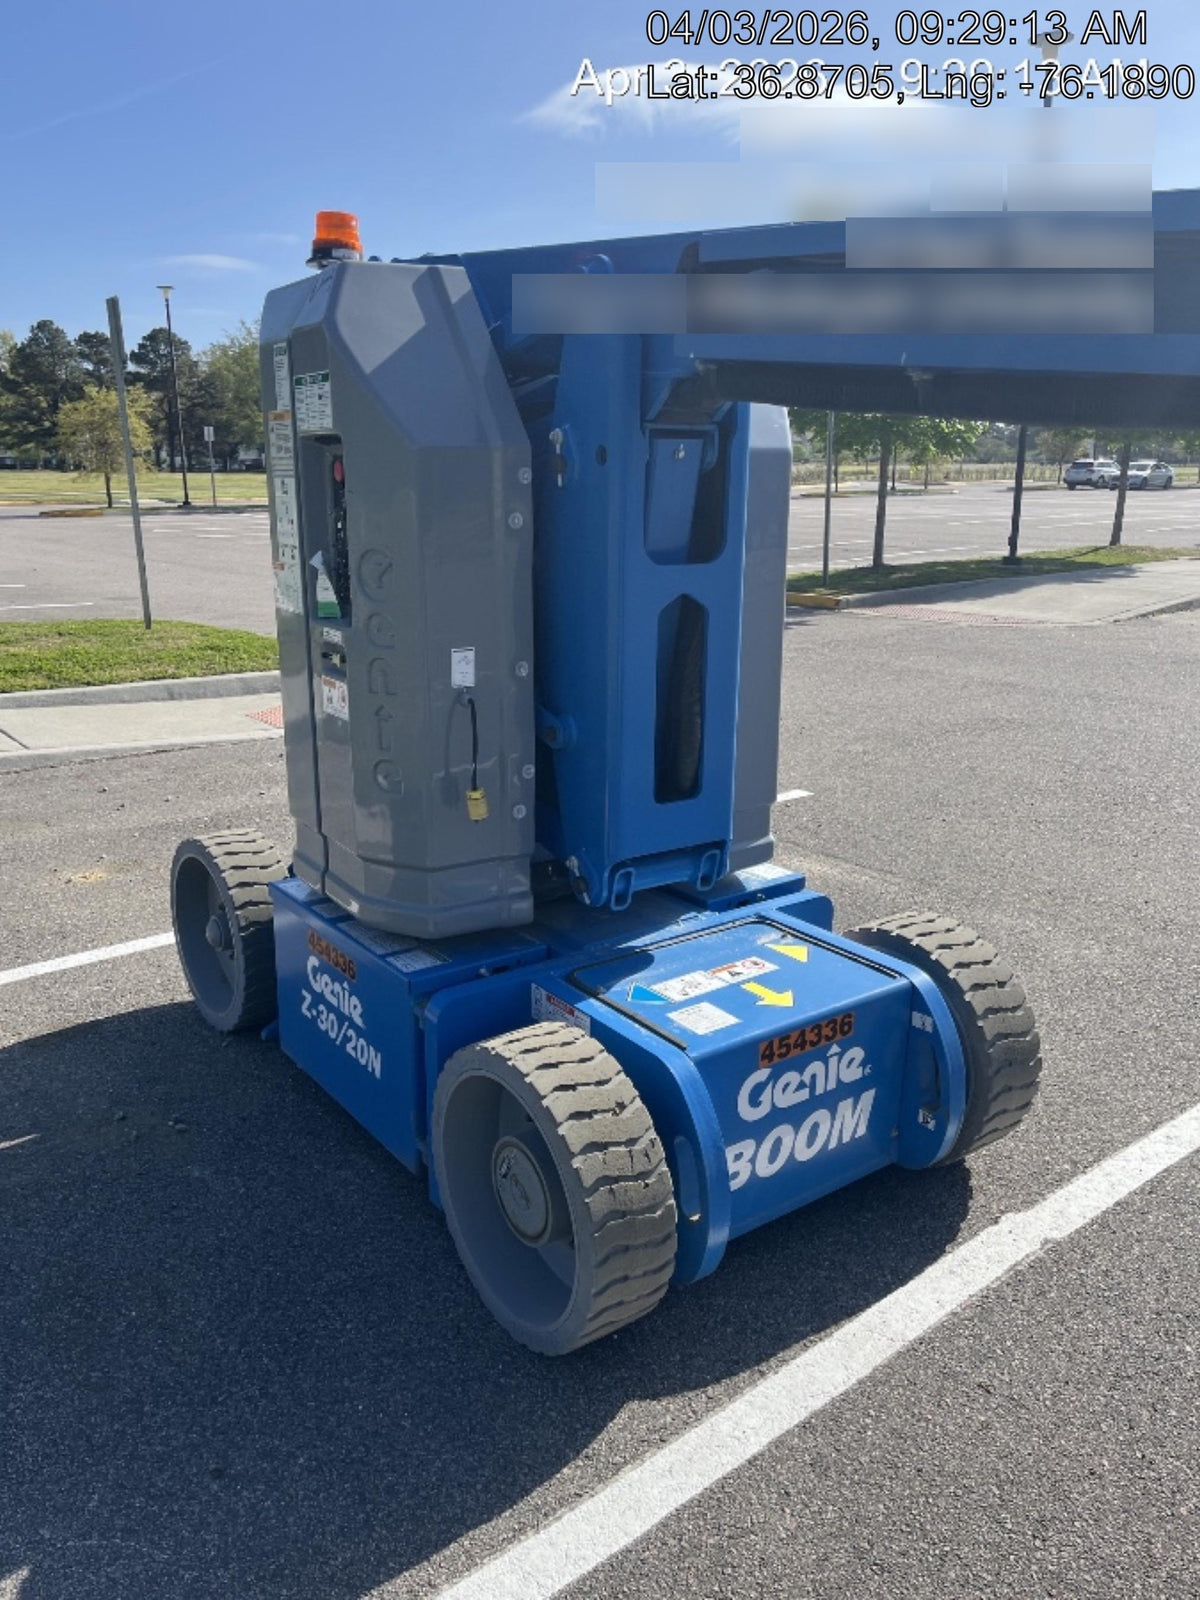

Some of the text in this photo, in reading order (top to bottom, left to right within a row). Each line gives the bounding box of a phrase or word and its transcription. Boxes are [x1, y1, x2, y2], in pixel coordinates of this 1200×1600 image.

[307, 955, 366, 1030] Genie
[301, 988, 381, 1079] Z-30/20N
[760, 1015, 853, 1064] 454336
[737, 1043, 866, 1122] Genie
[726, 1087, 877, 1192] BOOM
